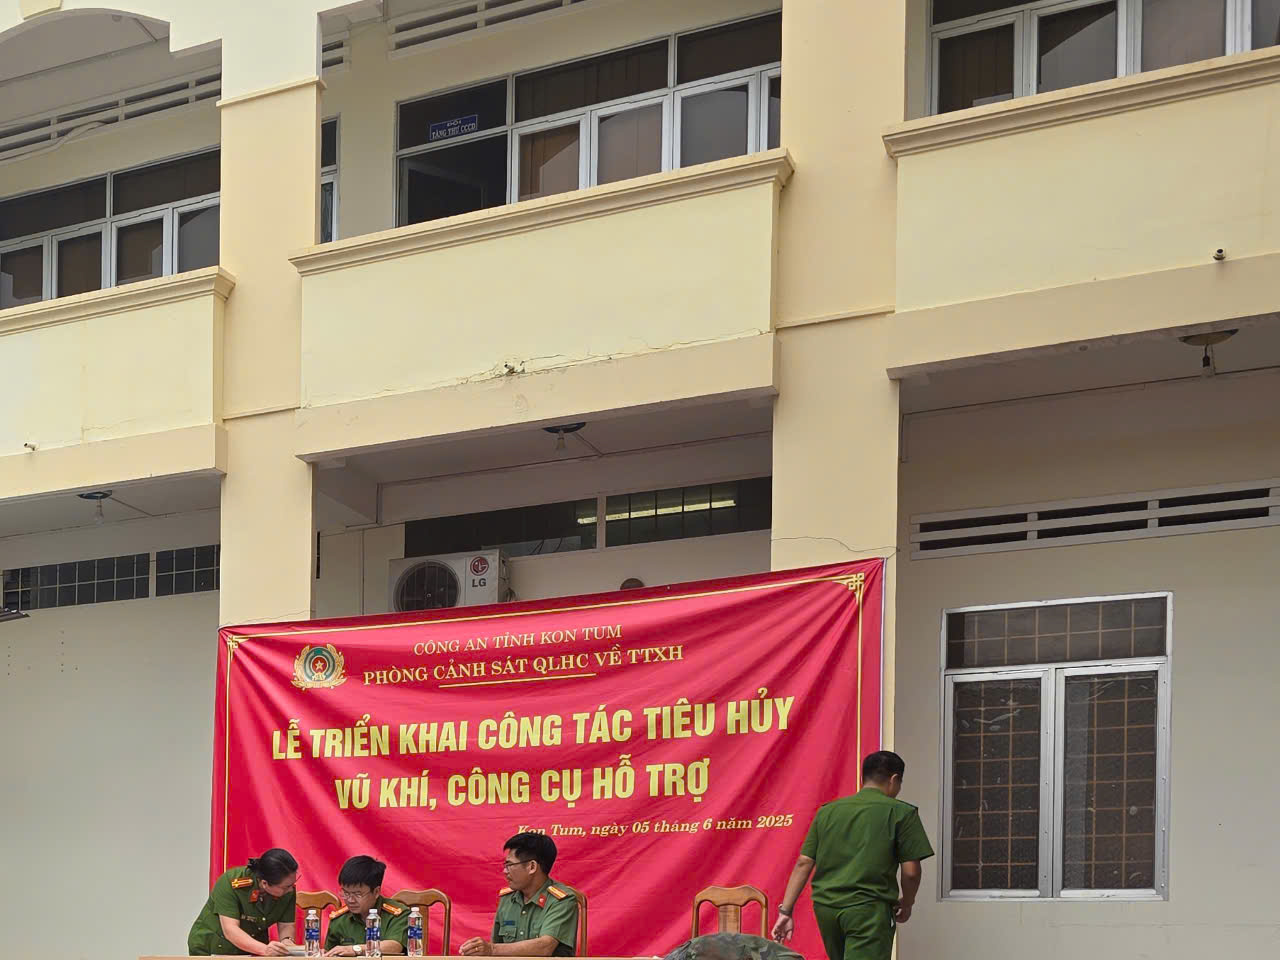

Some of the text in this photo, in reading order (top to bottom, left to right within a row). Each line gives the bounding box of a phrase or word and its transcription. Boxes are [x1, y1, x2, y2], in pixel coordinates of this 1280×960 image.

[472, 578, 487, 588] LG
[413, 624, 622, 656] CÔNG AN TỈNH KON TUM
[363, 643, 684, 686] PHÒNG CẢNH SÁT QLHC VỀ TTXH
[272, 687, 795, 760] LỄ TRIỂN KHAI CÔNG TÁC TIÊU HỦY
[335, 753, 710, 811] VŨ KHÍ, CÔNG CỤ HỖ TRỢ
[551, 824, 587, 837] Tum,
[590, 823, 628, 837] ngày
[632, 821, 651, 833] 05
[654, 820, 700, 834] tháng
[703, 818, 713, 830] 6
[716, 817, 752, 830] năm
[756, 814, 794, 828] 2025
